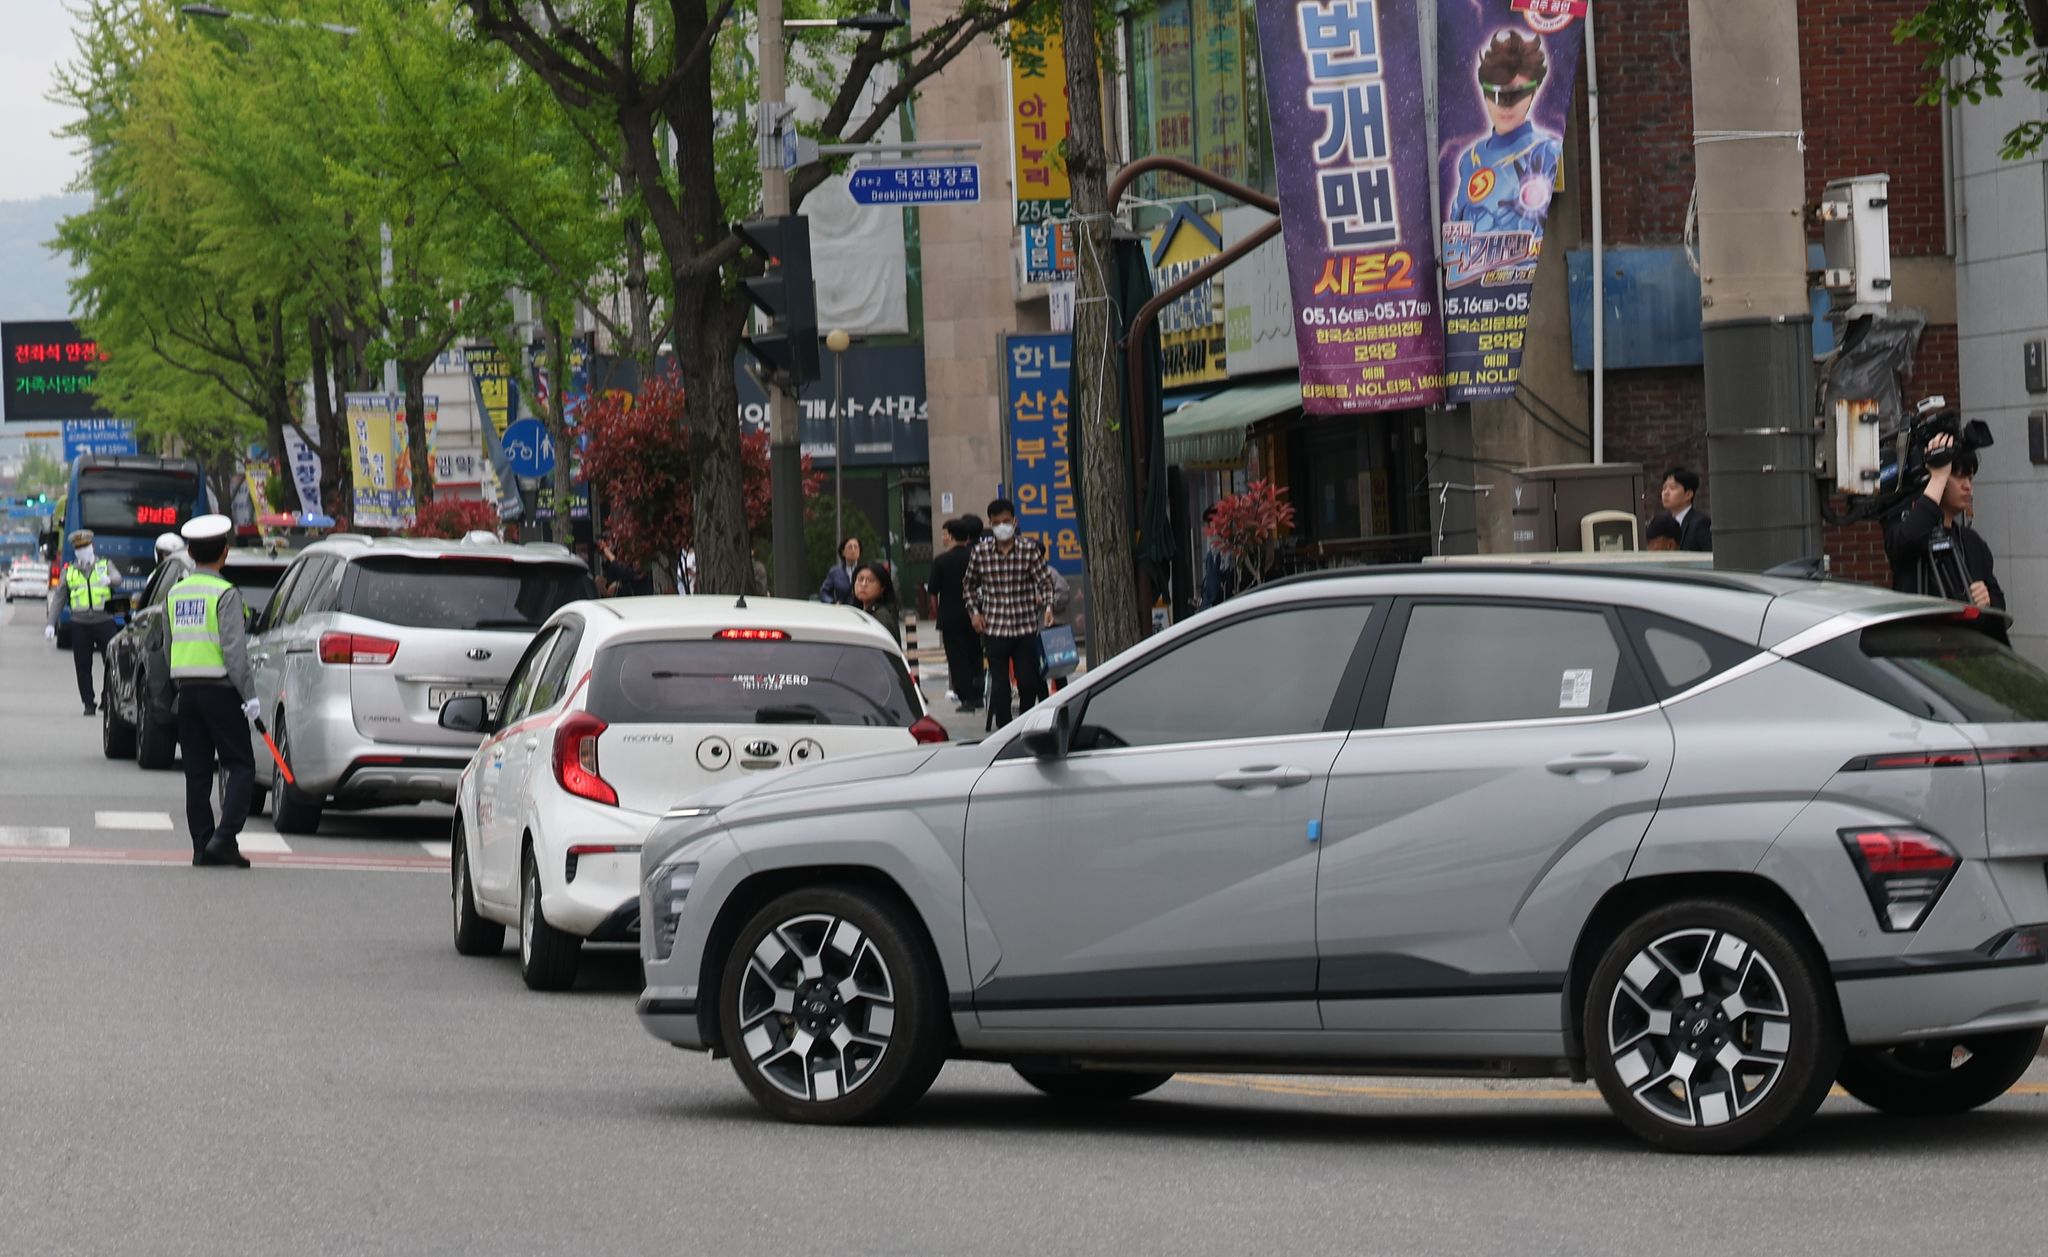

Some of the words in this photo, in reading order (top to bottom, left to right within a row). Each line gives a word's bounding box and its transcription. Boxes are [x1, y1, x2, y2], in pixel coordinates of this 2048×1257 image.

[1298, 0, 1401, 249] 번개맨
[895, 168, 974, 187] 덕진광장로
[871, 189, 975, 202] Deokjingwangjang-ro
[1313, 251, 1414, 295] 시즌2
[1316, 321, 1423, 344] 한국소리문화의전당
[1478, 331, 1523, 351] 모악당
[15, 343, 60, 364] 전좌석
[1354, 342, 1397, 362] 모악당
[1483, 353, 1509, 368] 예매
[1362, 366, 1385, 381] 예매
[176, 617, 205, 627] POLICE
[469, 649, 490, 660] KIA
[623, 733, 674, 744] morning
[750, 742, 776, 755] KIA
